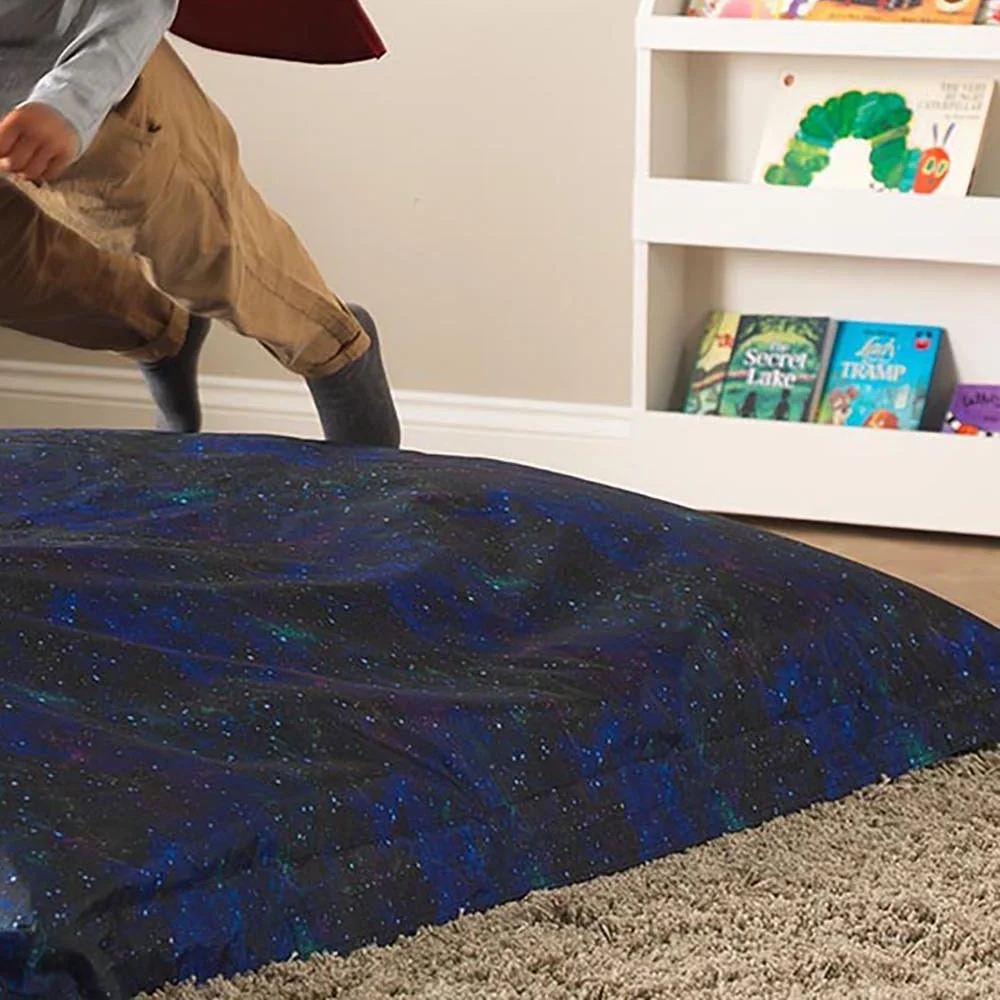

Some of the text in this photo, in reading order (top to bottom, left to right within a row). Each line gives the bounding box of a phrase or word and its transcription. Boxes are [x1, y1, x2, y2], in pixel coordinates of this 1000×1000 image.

[743, 348, 808, 370] Secret
[746, 368, 797, 388] Lake
[842, 361, 907, 382] TRAMP
